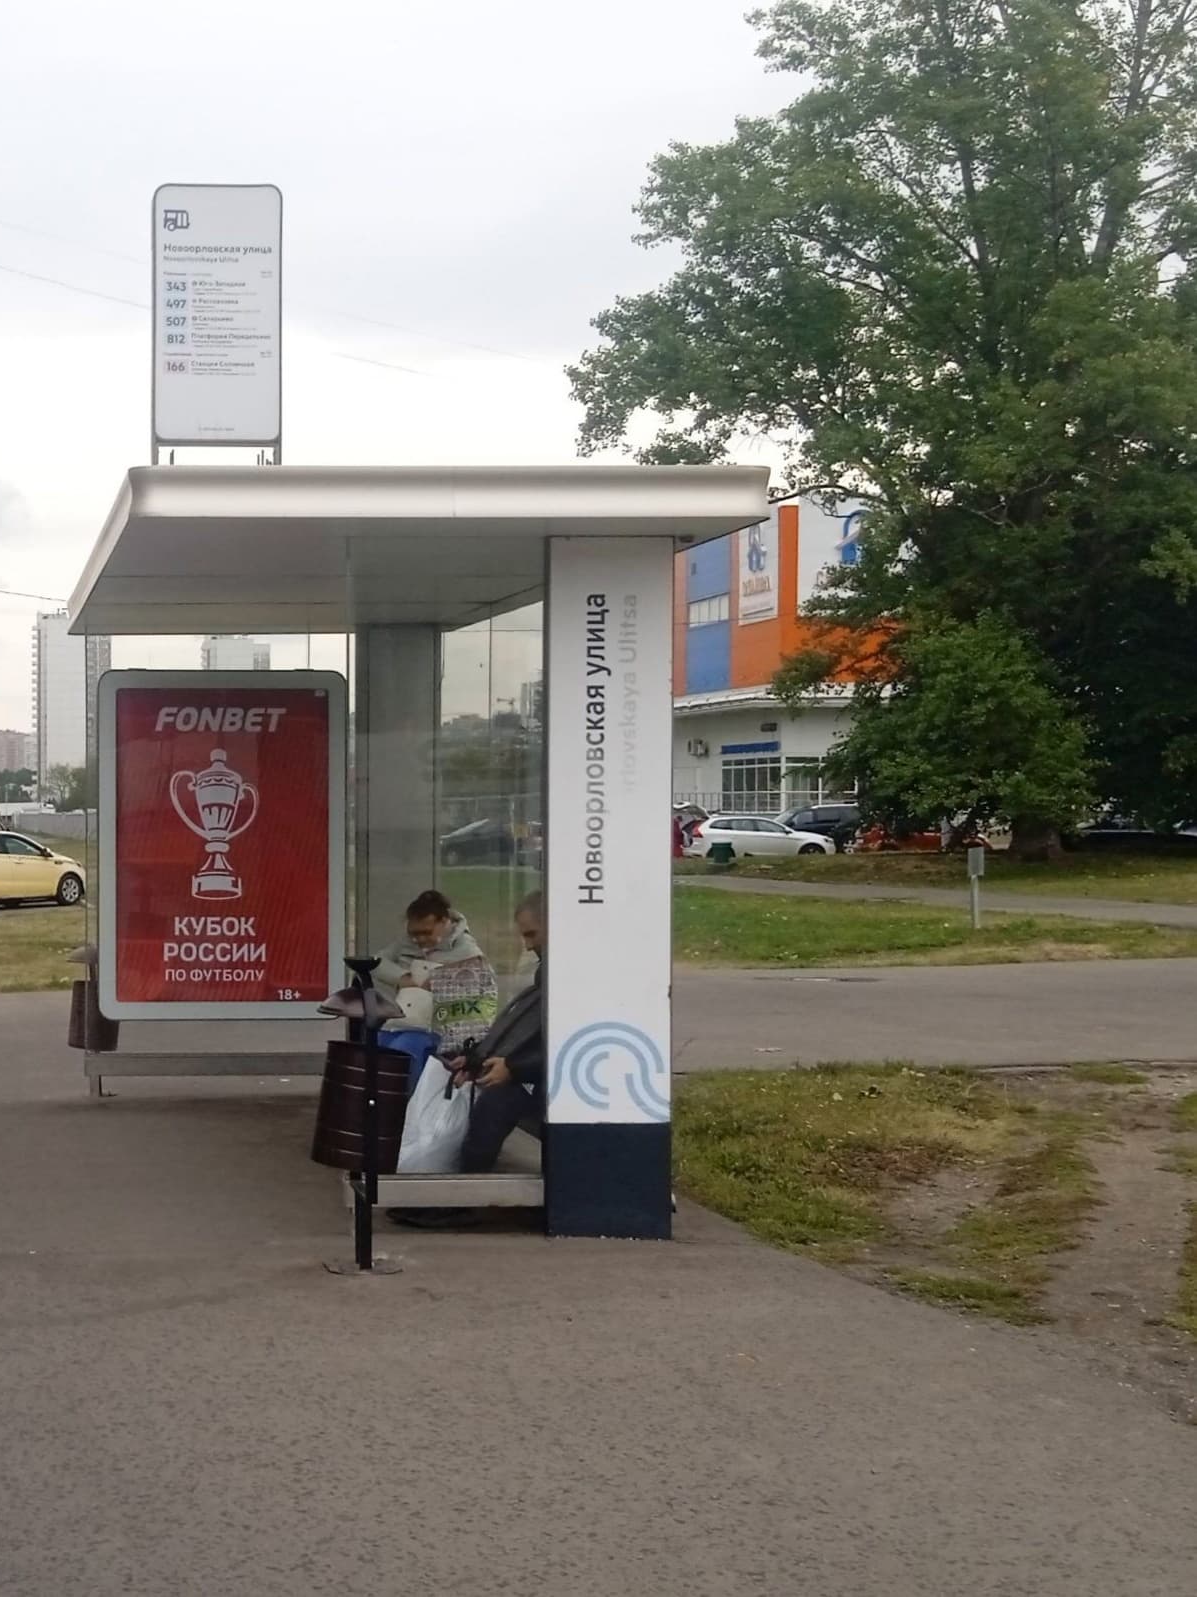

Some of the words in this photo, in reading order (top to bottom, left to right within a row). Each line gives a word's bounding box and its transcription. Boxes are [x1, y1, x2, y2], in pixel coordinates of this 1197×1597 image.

[163, 243, 241, 254] Новоорловская
[243, 245, 273, 256] улица
[166, 281, 187, 292] 343
[166, 299, 187, 309] 497
[166, 316, 187, 327] 507
[166, 334, 186, 345] 812
[166, 361, 186, 372] 166
[586, 593, 612, 676] улица
[618, 594, 638, 664] Ulitsa
[155, 706, 287, 733] FONBET
[578, 685, 610, 904] Новоорловская
[173, 916, 256, 937] КУБОК
[163, 942, 267, 963] РОССИИ
[165, 968, 186, 982] ПО
[190, 968, 265, 982] ФУТБОЛУ
[277, 989, 301, 1001] 18+
[450, 1000, 481, 1017] FIX
